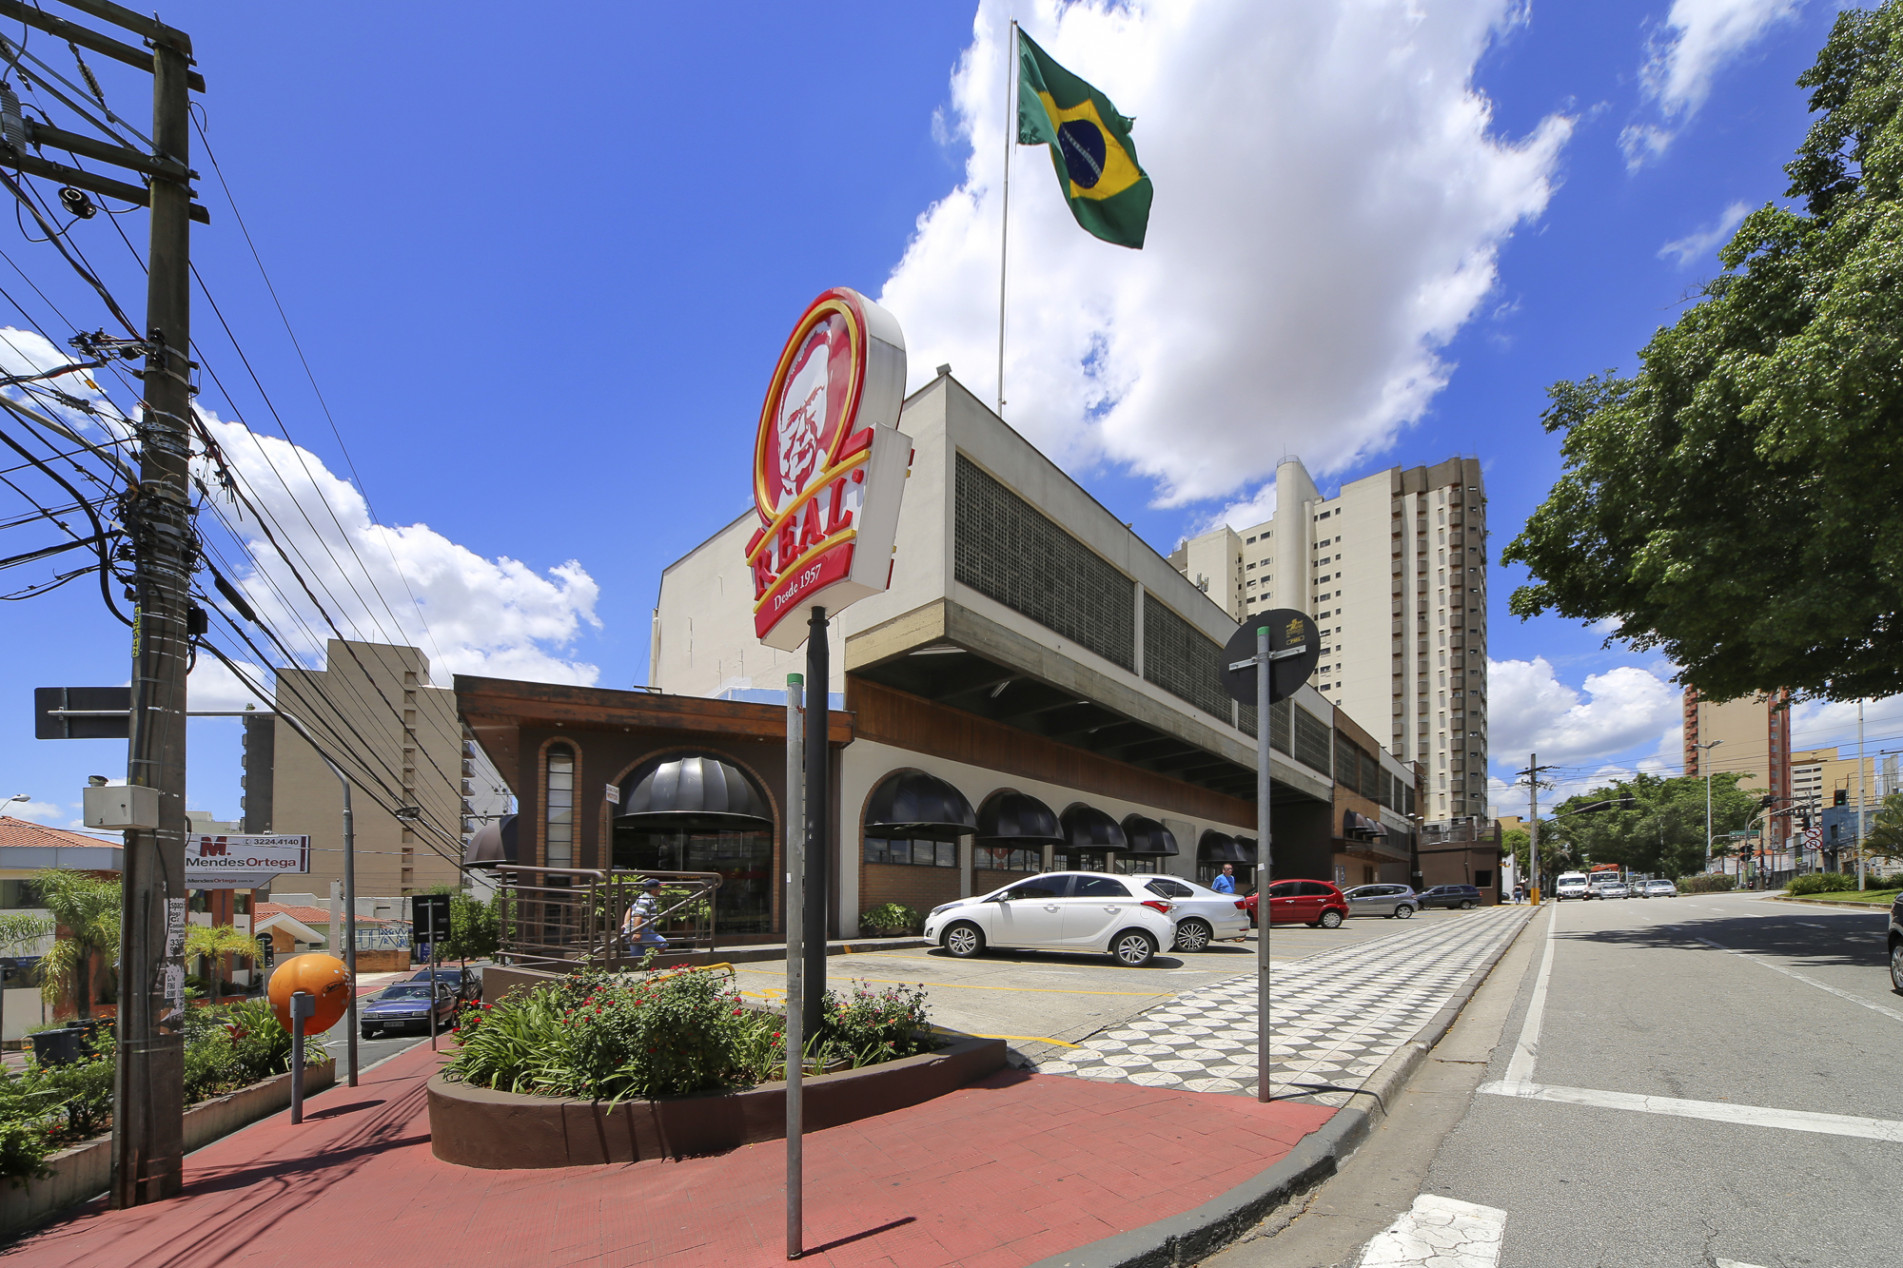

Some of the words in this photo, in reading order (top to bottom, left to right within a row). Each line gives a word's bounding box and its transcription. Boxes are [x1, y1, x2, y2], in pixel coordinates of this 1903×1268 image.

[752, 477, 854, 601] REAL
[773, 581, 799, 611] Desde
[799, 563, 822, 589] 1957
[186, 857, 297, 868] MendesOrtega
